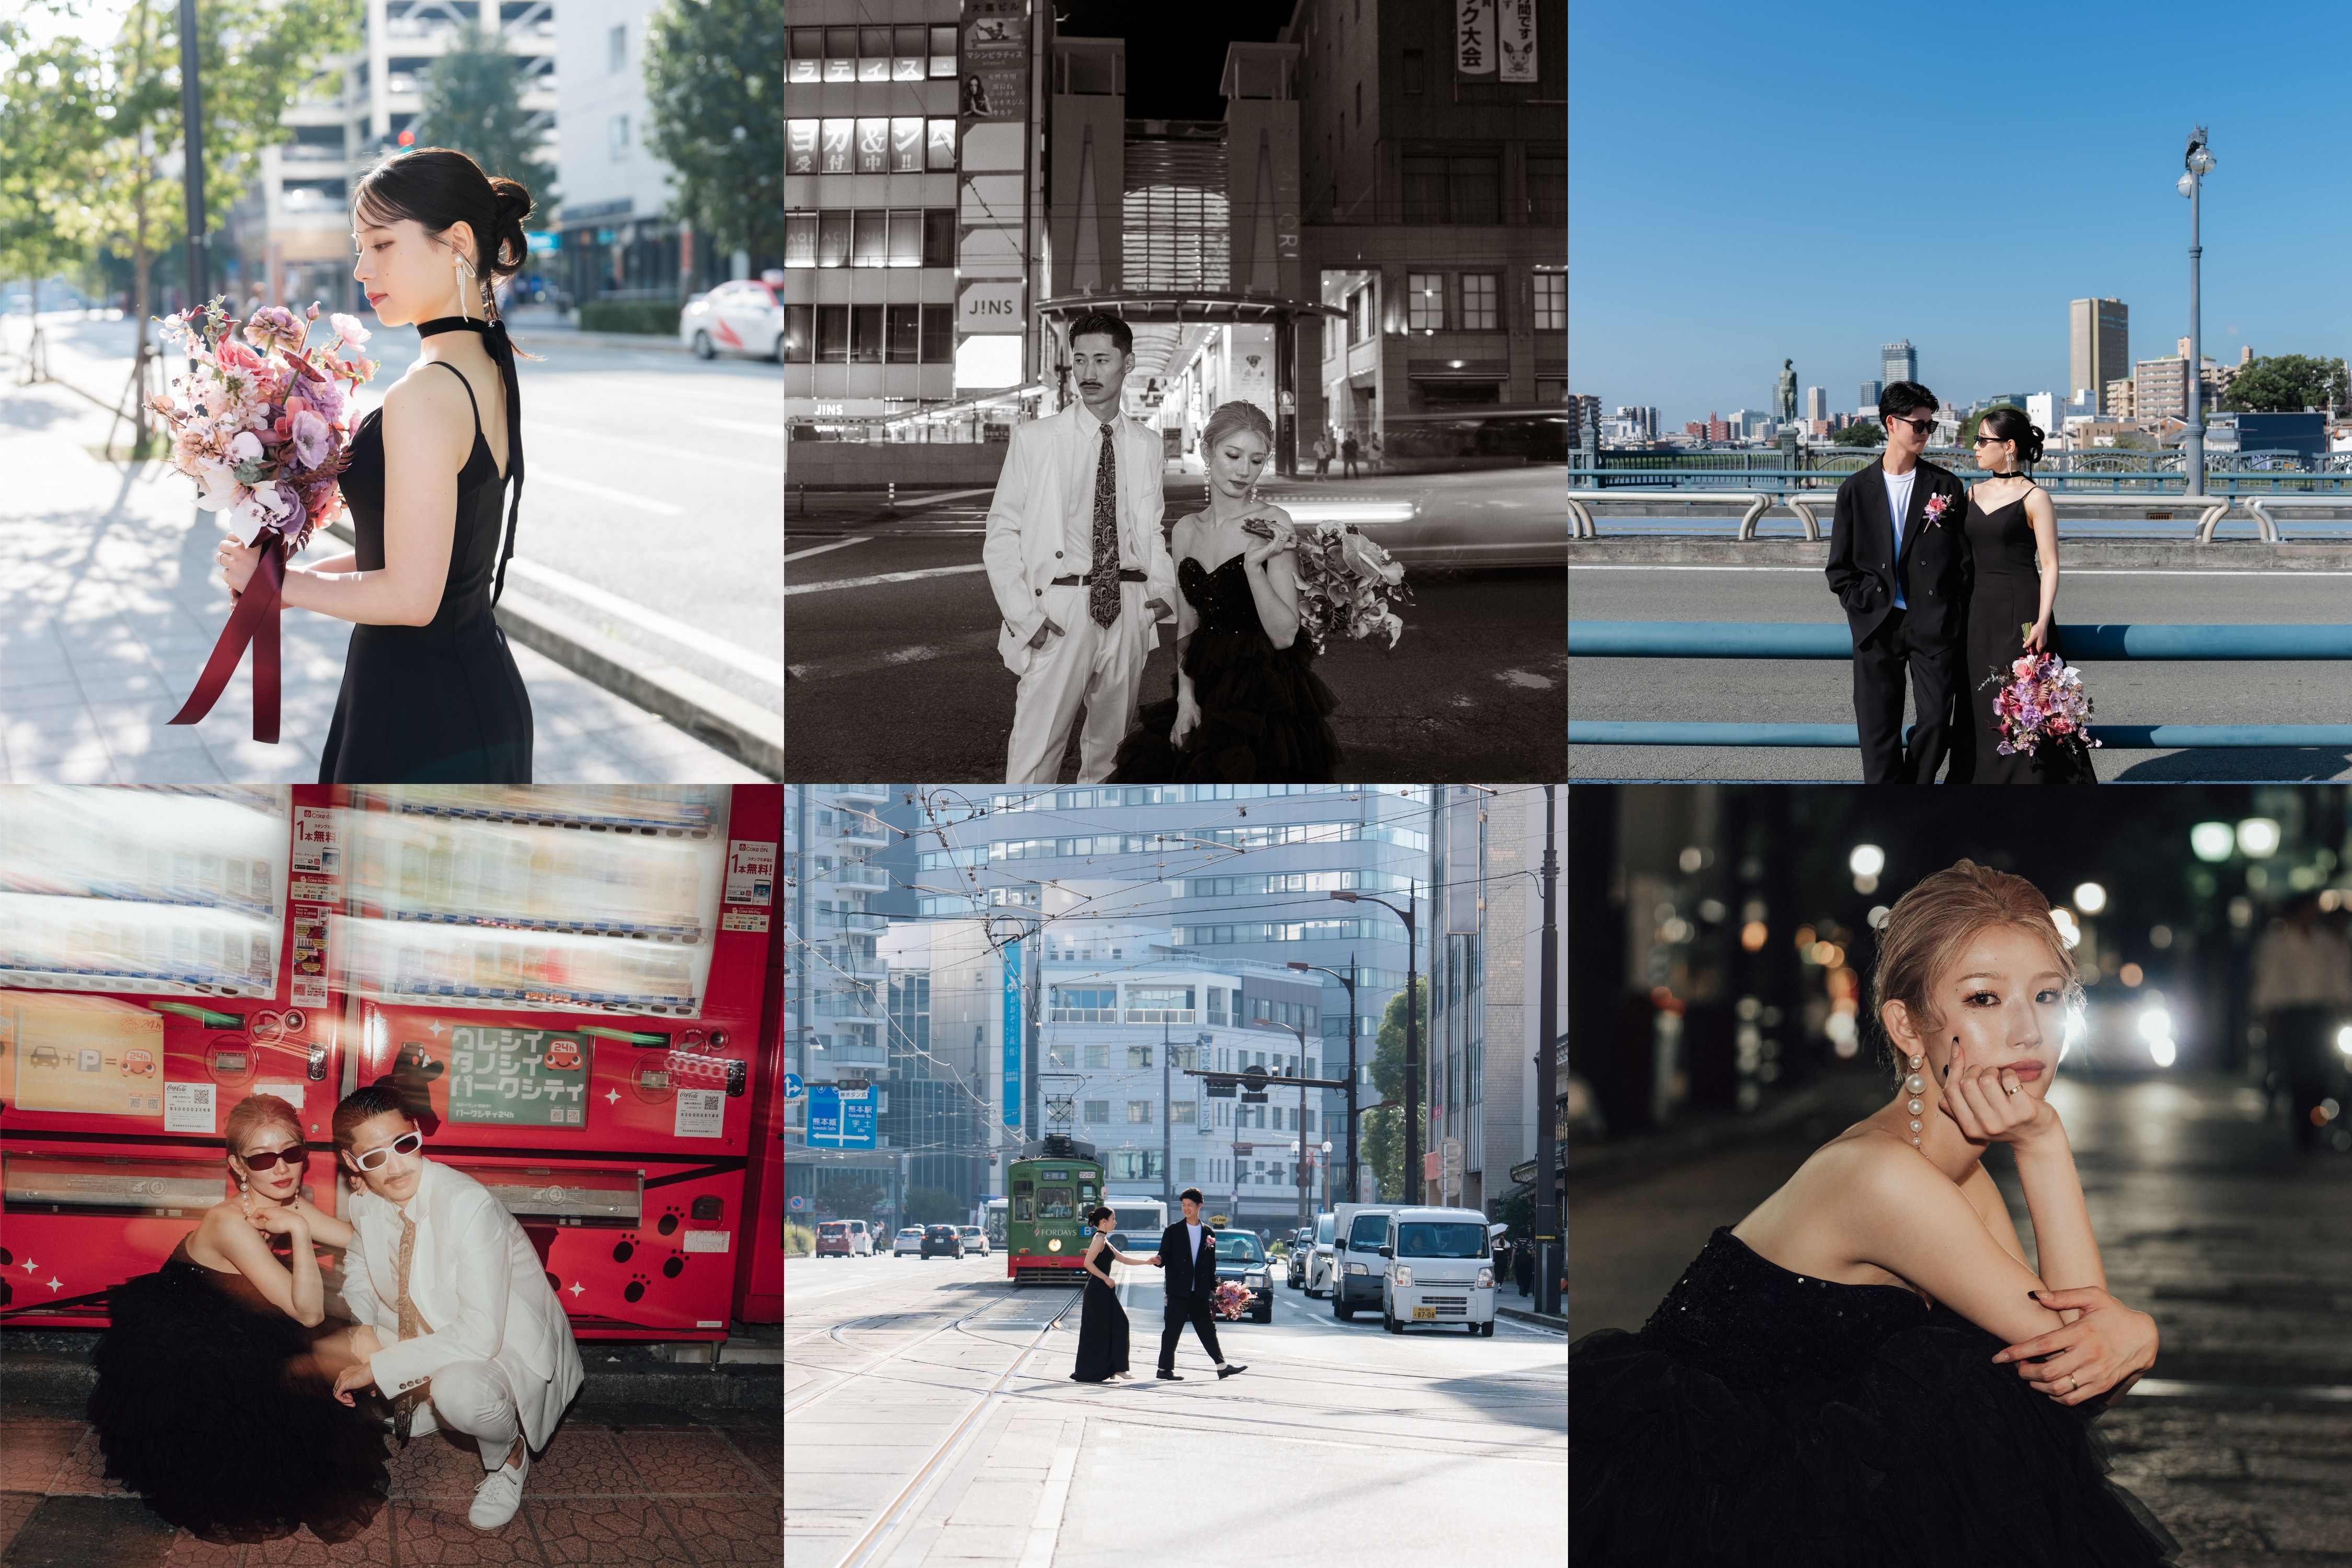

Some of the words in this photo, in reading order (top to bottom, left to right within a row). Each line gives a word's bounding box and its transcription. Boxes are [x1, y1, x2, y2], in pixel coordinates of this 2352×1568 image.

[141, 1019, 162, 1030] 24h
[453, 1028, 544, 1053] ウレシイ
[554, 1043, 574, 1052] 24h
[81, 1050, 100, 1070] P
[130, 1052, 148, 1060] 24h
[451, 1052, 543, 1076] タノシイ
[451, 1075, 584, 1101] パークシティ
[456, 1109, 514, 1119] パークシティ24h
[813, 1117, 836, 1126] 熊本城
